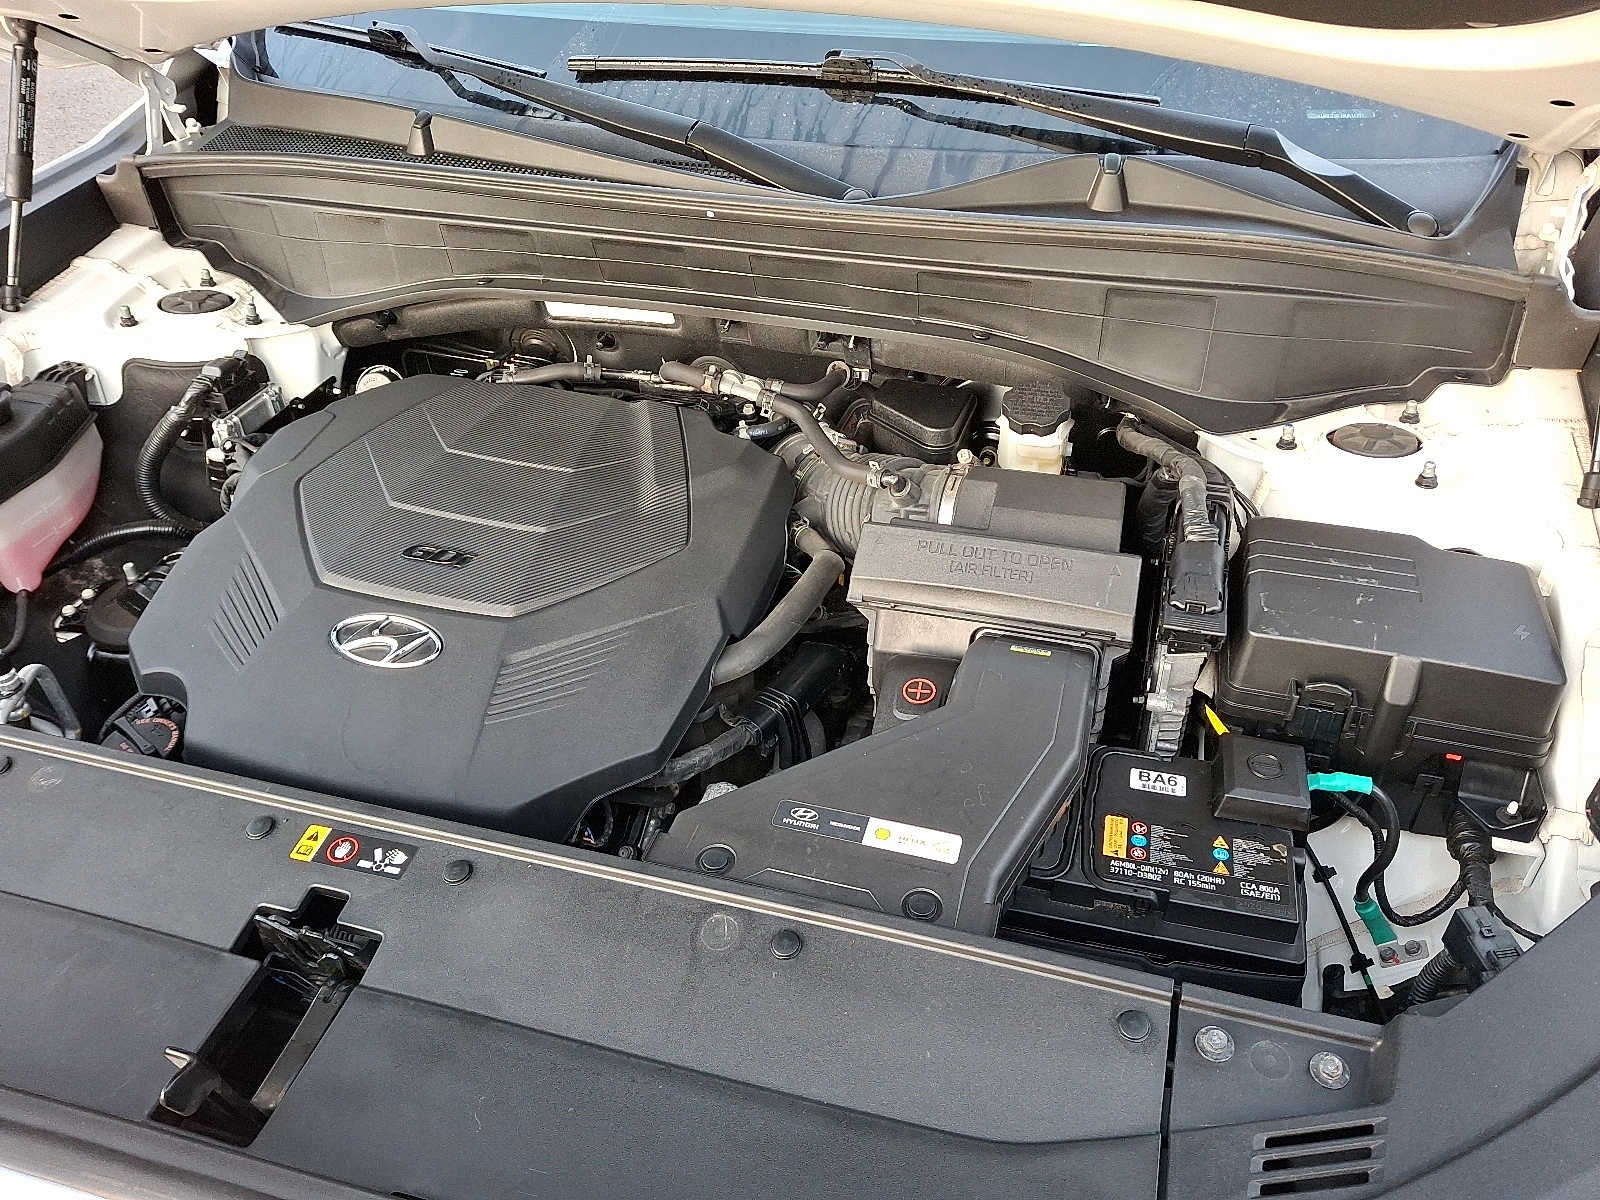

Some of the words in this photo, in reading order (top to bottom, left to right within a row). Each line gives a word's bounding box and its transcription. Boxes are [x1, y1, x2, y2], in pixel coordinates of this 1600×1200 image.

[917, 539, 957, 558] PULL
[962, 546, 997, 564] OUT
[1002, 549, 1023, 566] TO
[1028, 553, 1073, 573] OPEN
[1138, 770, 1178, 787] BA6
[1197, 874, 1226, 885] (20HR)
[1239, 881, 1257, 892] CCA
